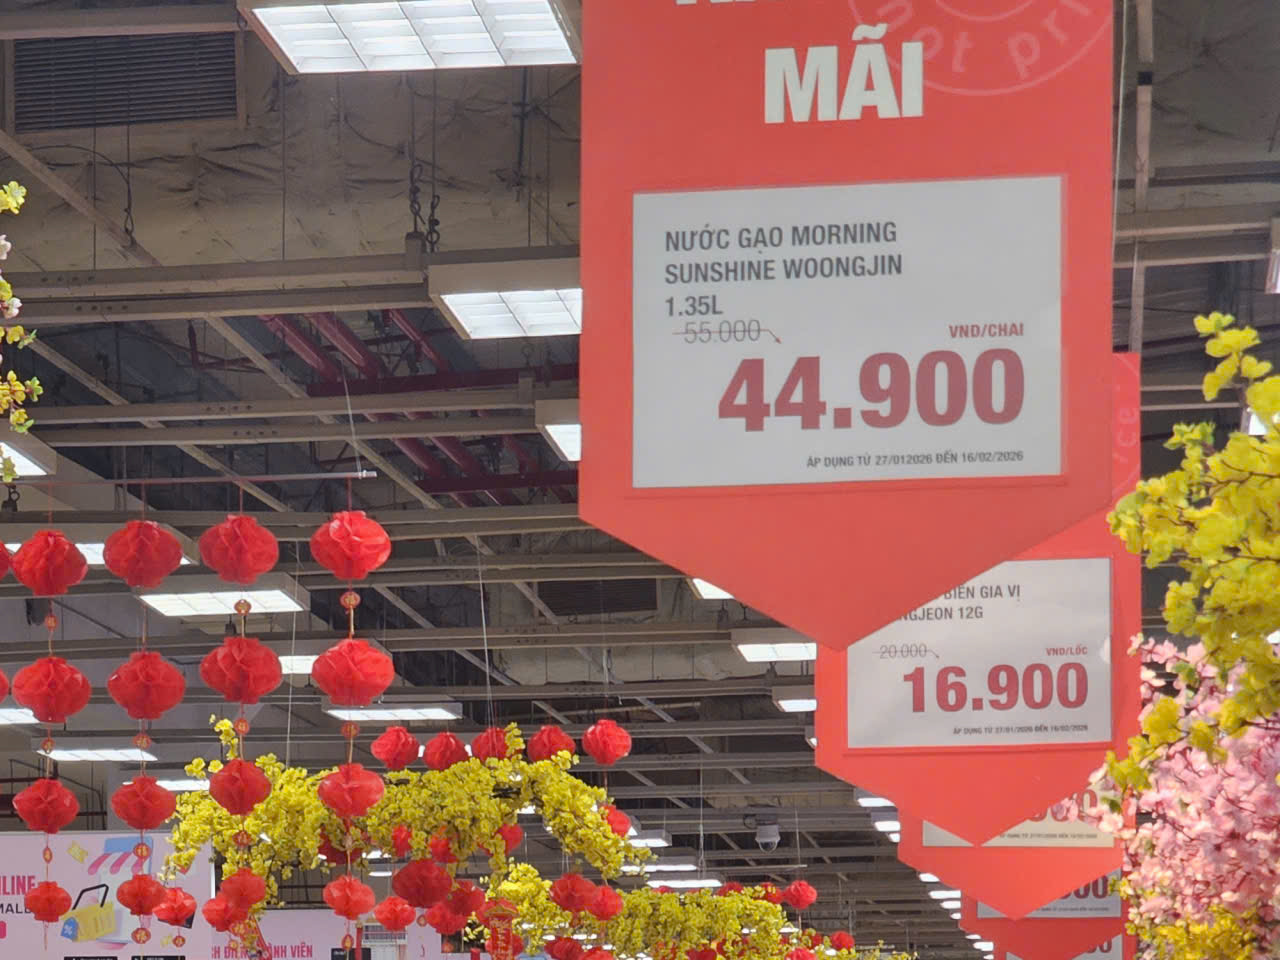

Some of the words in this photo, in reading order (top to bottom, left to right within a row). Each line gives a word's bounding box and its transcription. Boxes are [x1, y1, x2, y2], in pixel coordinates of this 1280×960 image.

[764, 22, 923, 123] MÃI
[665, 224, 730, 252] NƯỚC
[738, 226, 784, 255] GẠO
[791, 221, 898, 247] MORNING
[665, 259, 776, 285] SUNSHINE
[783, 253, 903, 280] WOONGJIN
[665, 294, 724, 318] 1.35L
[683, 318, 762, 344] 55.000
[948, 322, 1025, 340] VND/CHAI
[718, 348, 1025, 433] 44.900
[806, 455, 821, 469] ÁP
[823, 455, 854, 469] DỤNG
[857, 454, 871, 467] TỪ
[935, 449, 959, 465] ĐẾN
[961, 450, 1025, 464] 16/02/2026
[980, 585, 1004, 599] GIA
[1007, 584, 1021, 602] VỊ
[958, 606, 984, 620] 12G
[879, 643, 928, 660] 20.000
[1046, 644, 1089, 657] VND/LỐC
[903, 662, 1089, 714] 16.900
[294, 941, 313, 957] VIÊN
